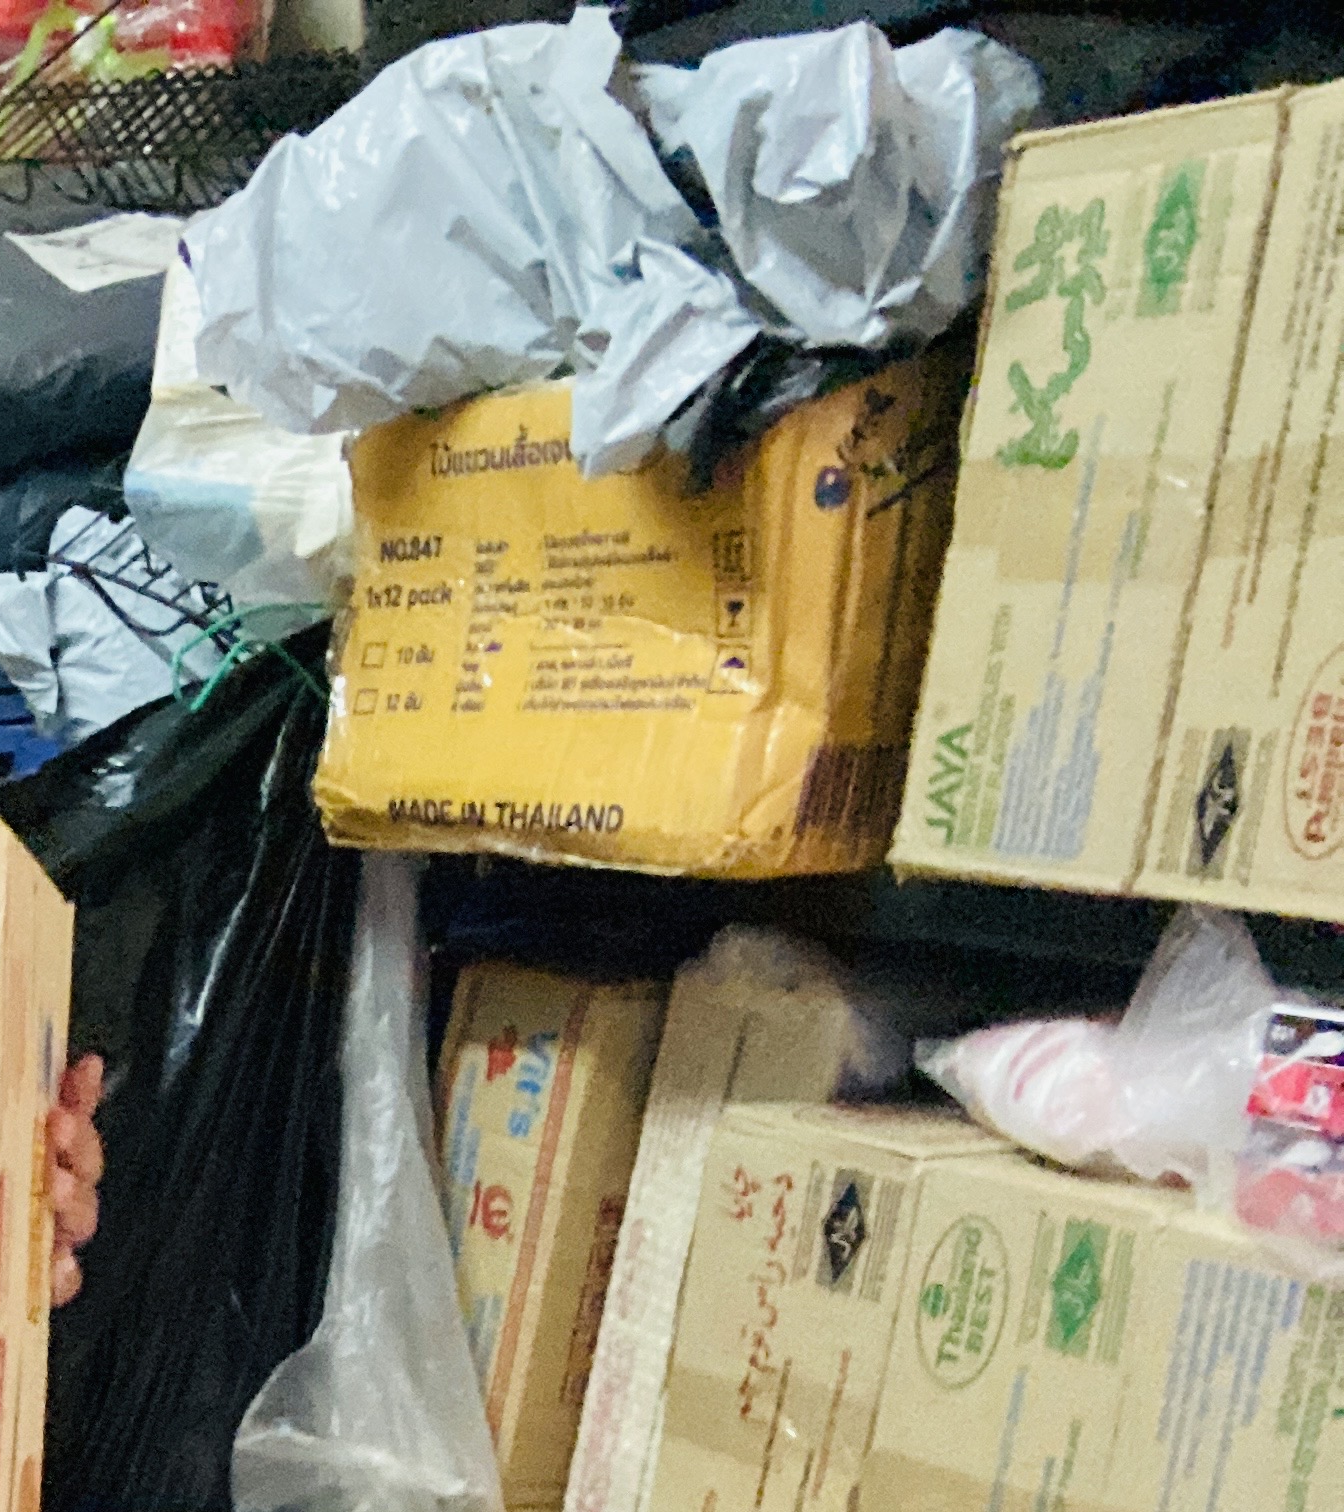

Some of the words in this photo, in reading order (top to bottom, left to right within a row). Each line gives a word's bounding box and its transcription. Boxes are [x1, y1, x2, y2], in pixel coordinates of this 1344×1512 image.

[388, 799, 461, 825] MADE
[464, 800, 486, 827] IN
[495, 802, 625, 834] THAILAND
[926, 723, 974, 847] JAYA
[965, 1266, 996, 1355] BEST
